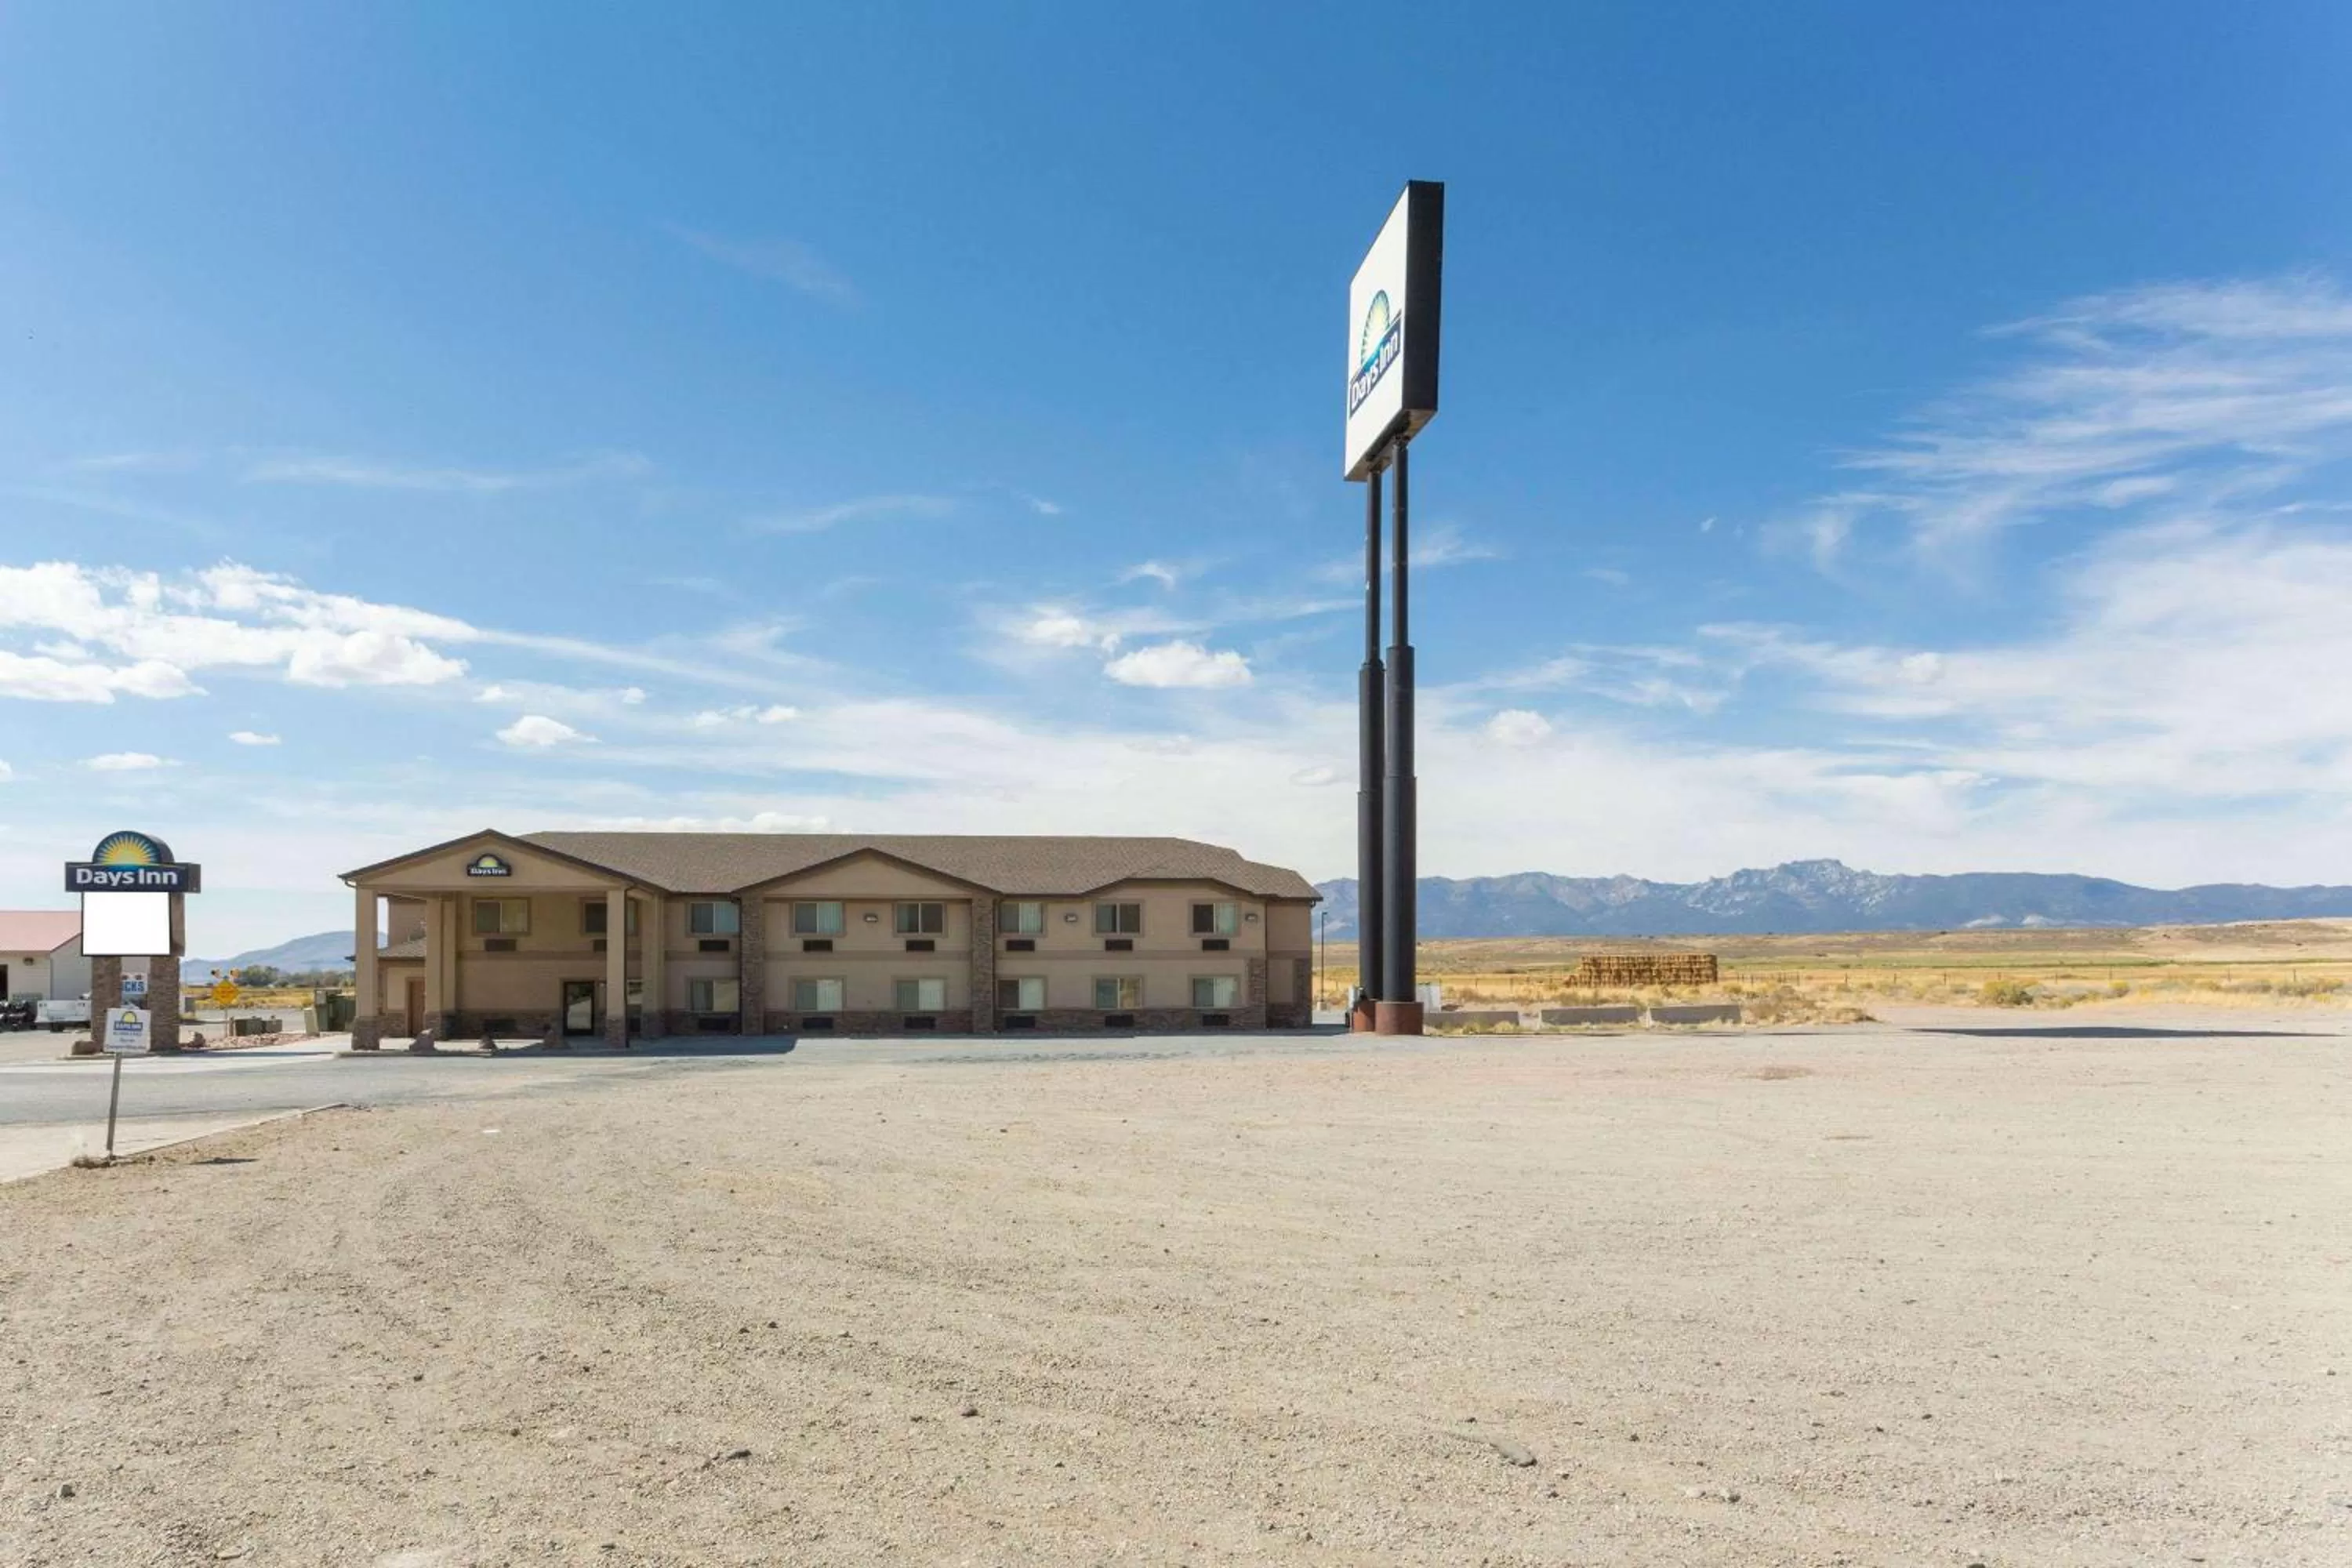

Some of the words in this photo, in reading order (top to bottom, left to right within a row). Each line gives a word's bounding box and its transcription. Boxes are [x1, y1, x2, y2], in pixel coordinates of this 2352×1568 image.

[1351, 358, 1379, 408] Days
[1379, 332, 1398, 372] Inn
[76, 868, 134, 887] Days
[138, 868, 178, 884] Inn
